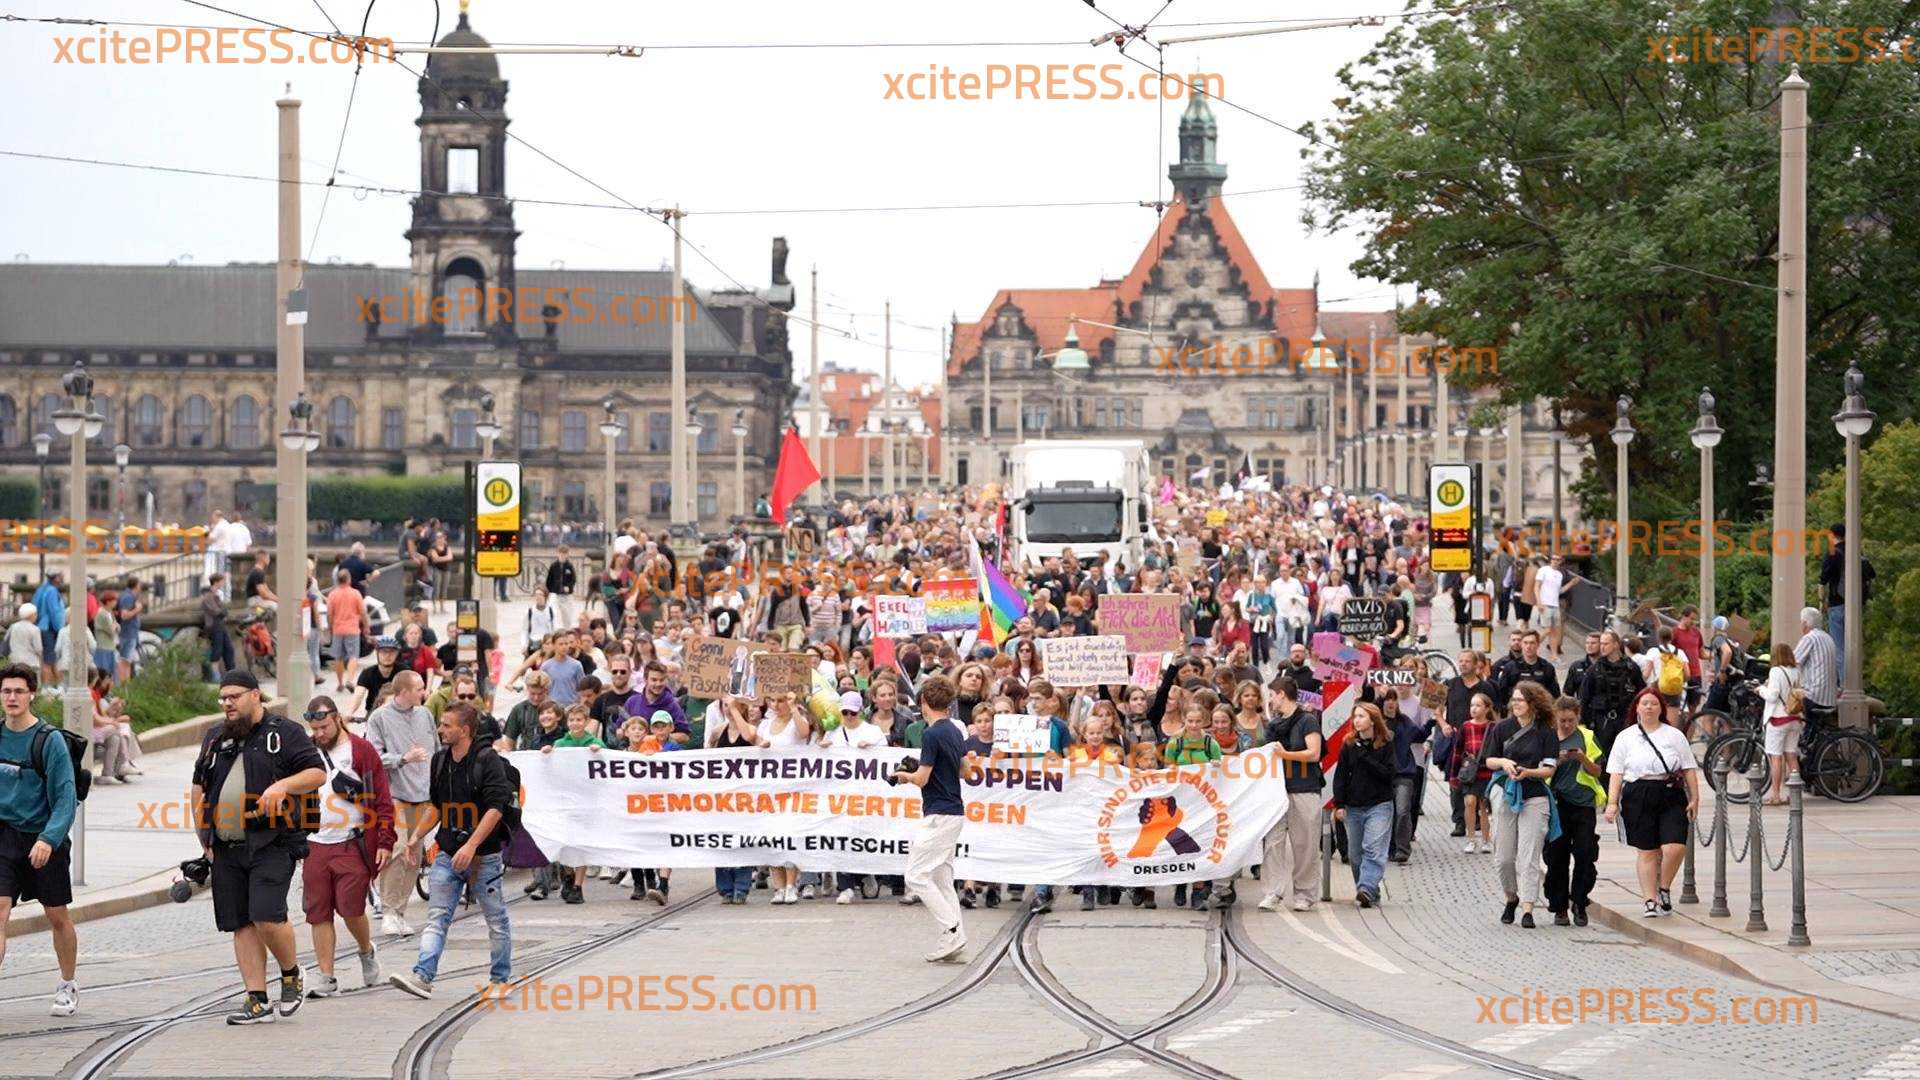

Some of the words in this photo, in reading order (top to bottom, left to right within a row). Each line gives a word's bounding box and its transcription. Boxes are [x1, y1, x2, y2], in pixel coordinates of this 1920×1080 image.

[492, 483, 504, 500] H
[1445, 485, 1457, 501] H
[1346, 600, 1383, 614] NAZIS
[1367, 671, 1392, 685] FCK
[1394, 671, 1416, 685] NZS
[588, 758, 899, 781] RECHTSEXTREMISMU
[964, 765, 1063, 792] OPPEN
[627, 791, 818, 814] DEMOKRATIE
[828, 793, 1026, 825] VERTEGEN
[1098, 788, 1128, 828] SIND
[1129, 774, 1160, 792] DIE
[670, 833, 733, 849] DIESE
[740, 834, 797, 851] WAHL
[1133, 862, 1196, 875] DRESDEN
